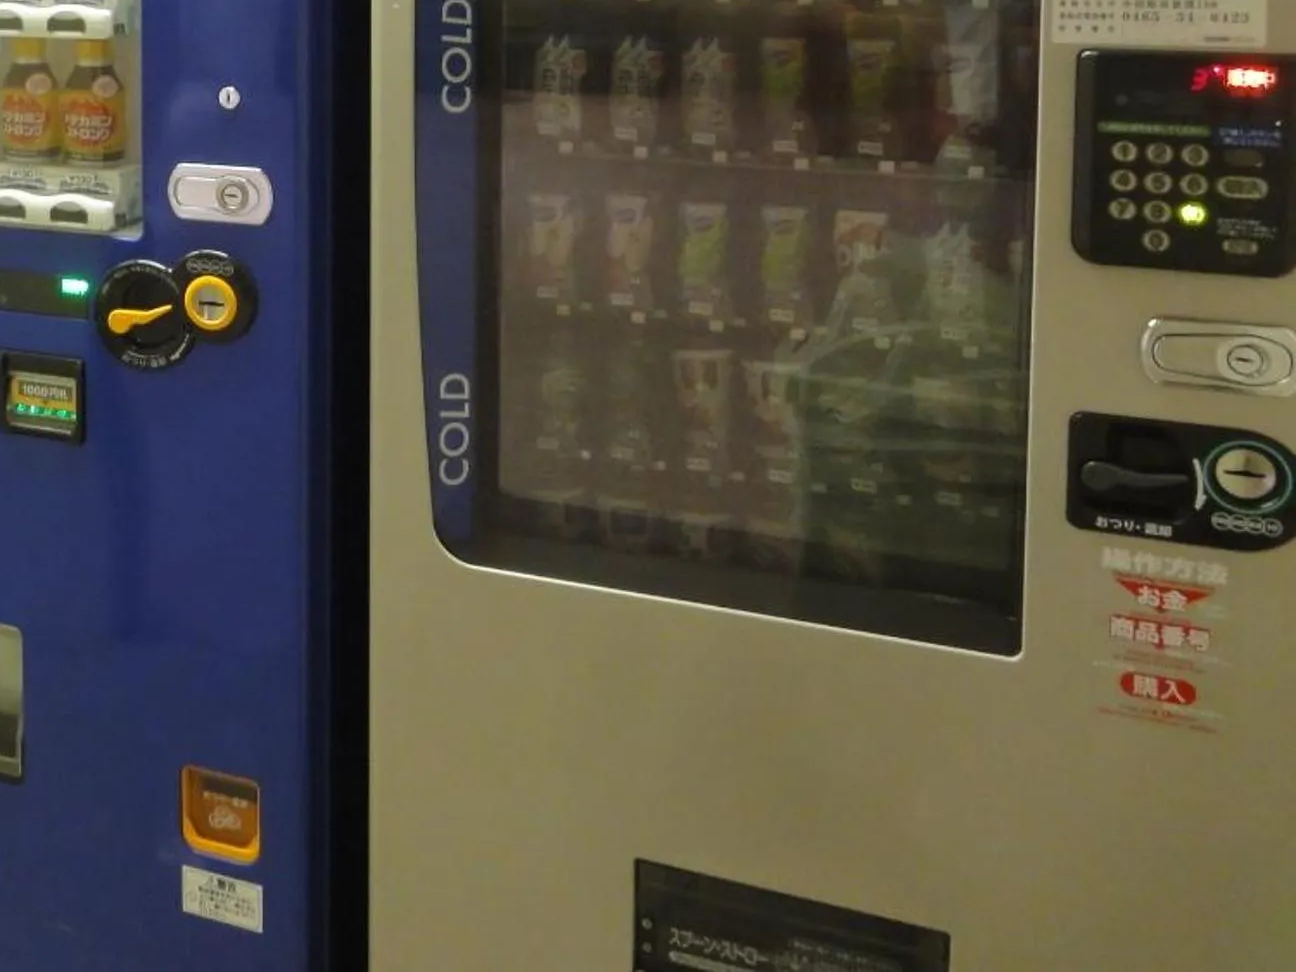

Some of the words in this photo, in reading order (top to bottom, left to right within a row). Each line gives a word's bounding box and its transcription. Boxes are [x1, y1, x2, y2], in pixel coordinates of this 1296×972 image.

[439, 373, 471, 486] COLD
[1137, 585, 1189, 612] お金
[1109, 615, 1210, 652] 商品番号
[1131, 673, 1186, 704] 購入
